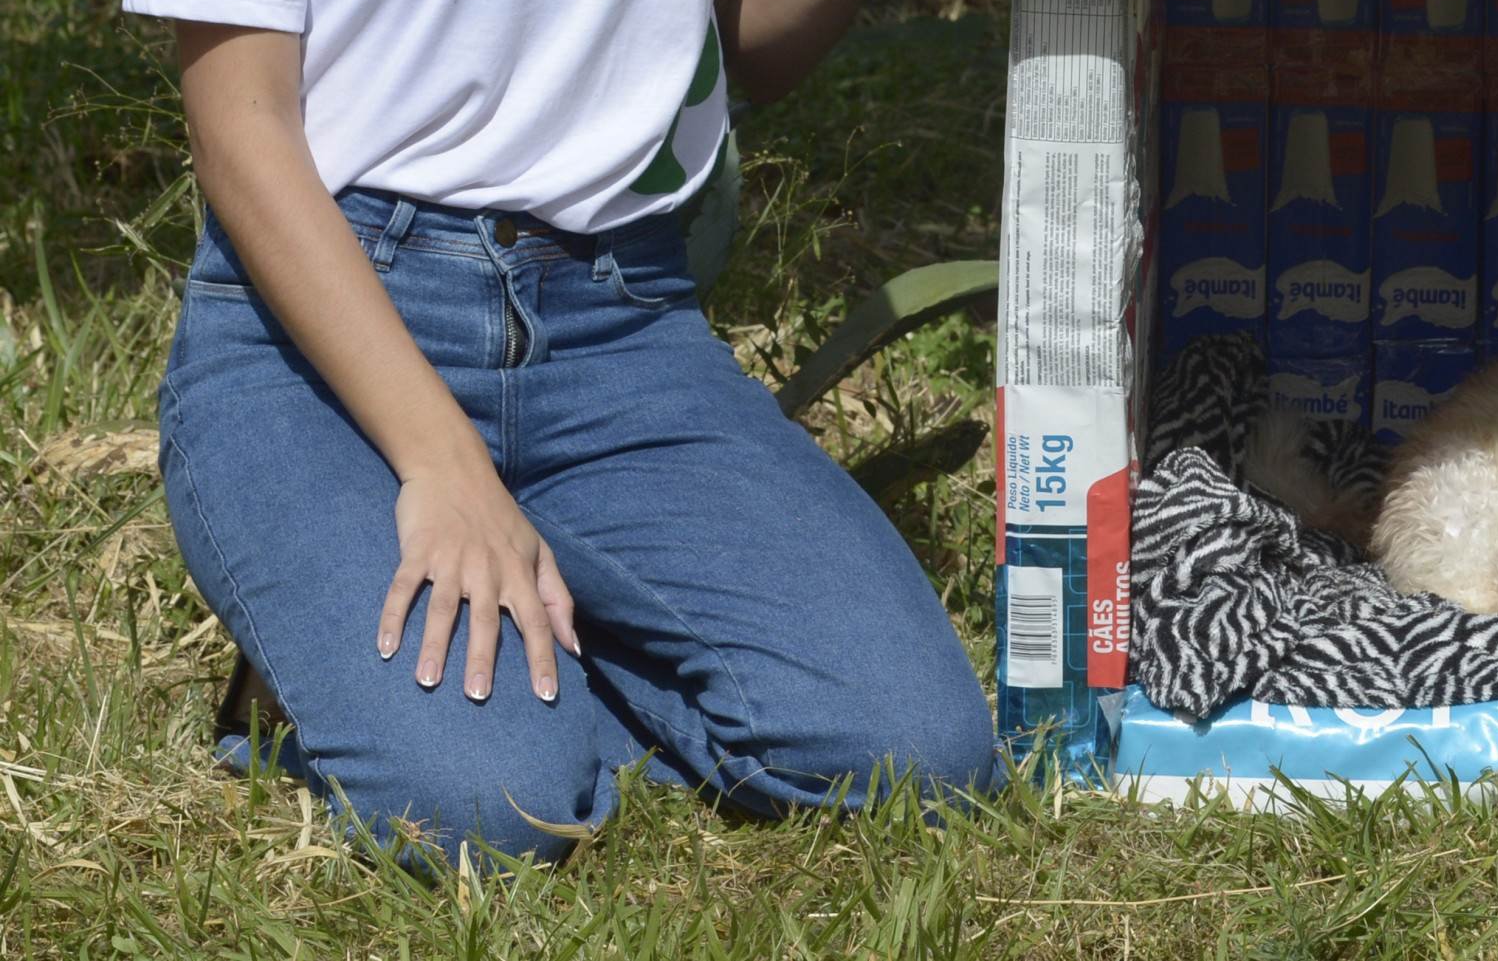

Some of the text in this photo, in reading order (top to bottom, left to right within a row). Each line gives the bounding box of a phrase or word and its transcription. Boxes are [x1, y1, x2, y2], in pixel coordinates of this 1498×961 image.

[1184, 277, 1257, 302] itambé
[1290, 281, 1362, 305] itambé
[1393, 287, 1467, 311] itambé
[1383, 397, 1437, 421] itam
[1020, 434, 1030, 452] Wt
[1020, 454, 1030, 475] Net
[1035, 434, 1074, 513] 15kg
[1008, 482, 1017, 510] Peso
[1020, 486, 1030, 512] Neto
[1088, 599, 1114, 654] CÃES
